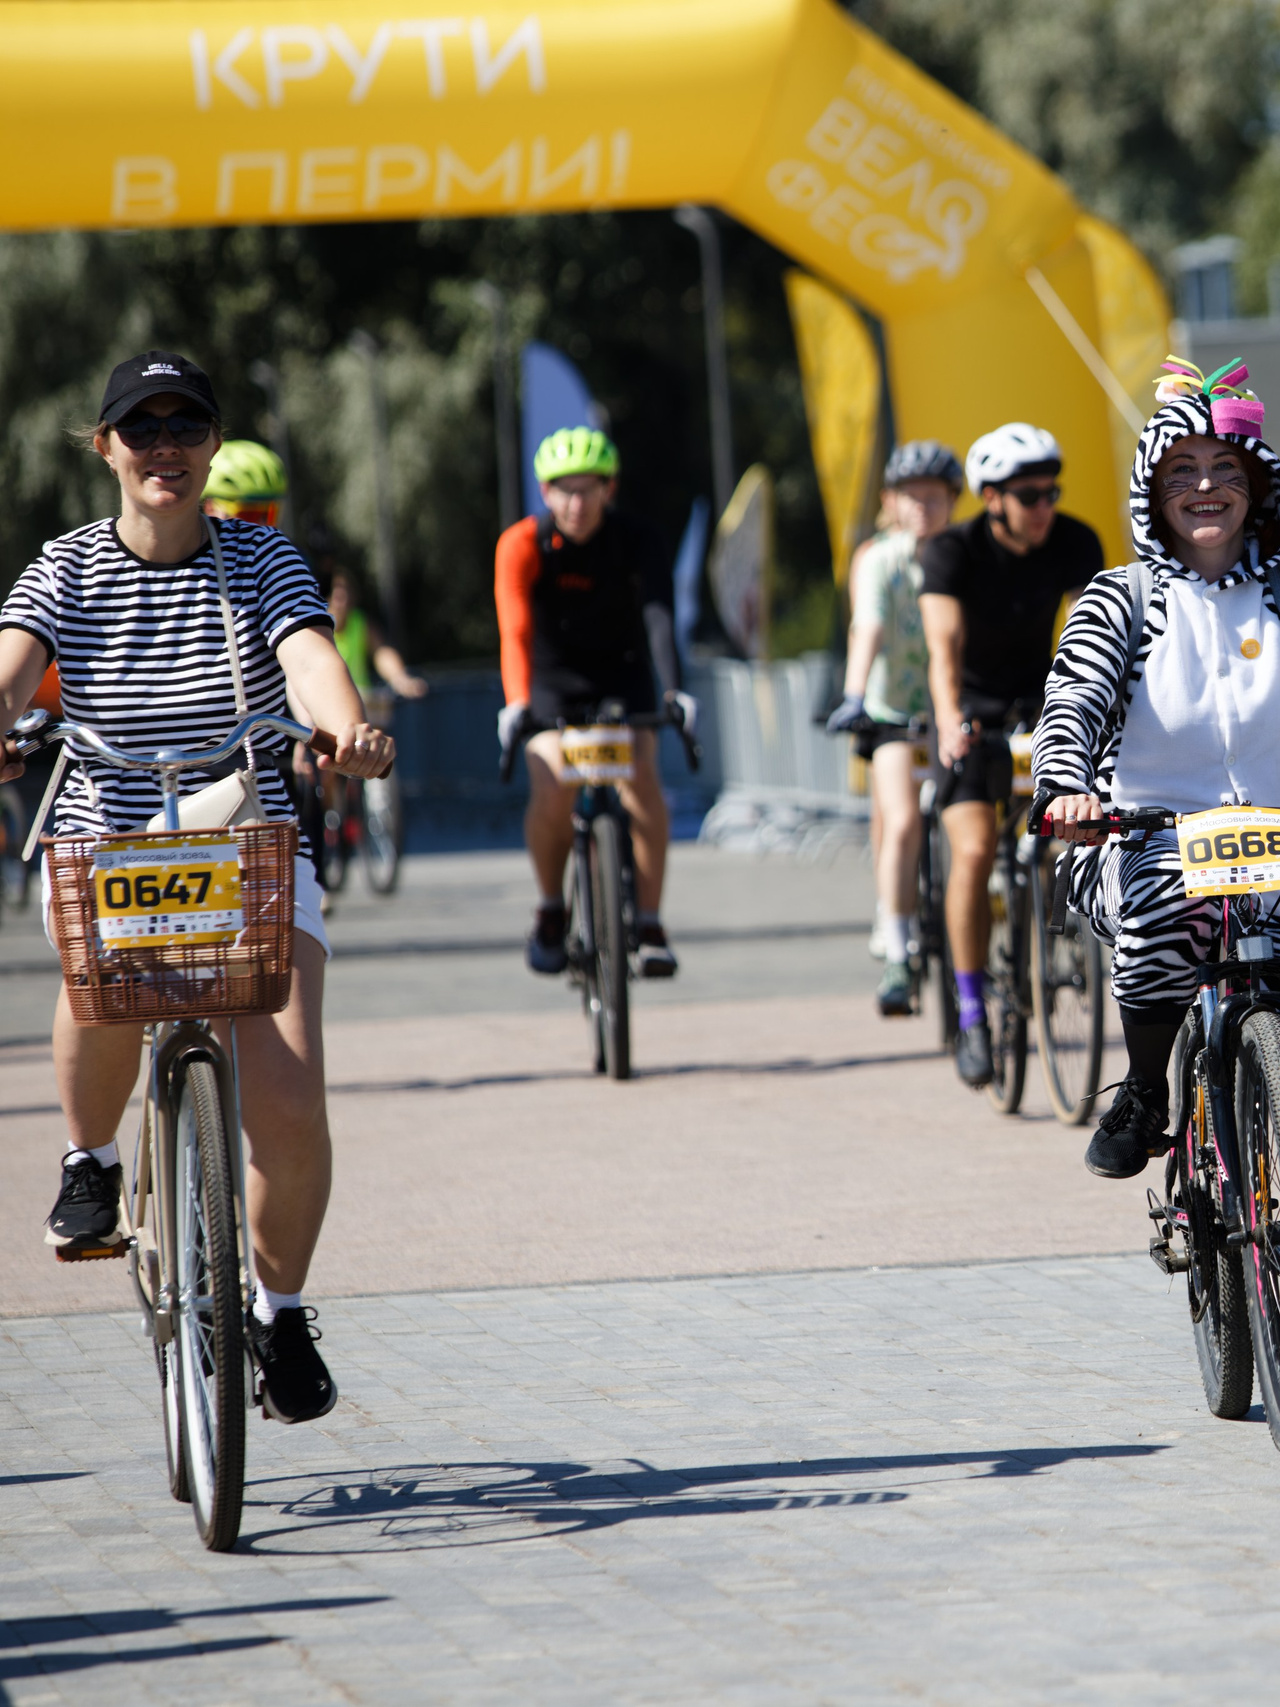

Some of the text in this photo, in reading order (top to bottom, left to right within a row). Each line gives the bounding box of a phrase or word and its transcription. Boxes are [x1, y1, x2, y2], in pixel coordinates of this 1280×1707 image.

[189, 15, 548, 110] КРУТИ
[111, 128, 632, 222] В ПЕРМИ!
[141, 369, 181, 377] WEEKEND
[148, 363, 174, 371] HELLO
[1200, 815, 1252, 828] Массовый
[119, 851, 177, 865] Массовый
[179, 851, 212, 861] заезд
[104, 871, 213, 910] 0647
